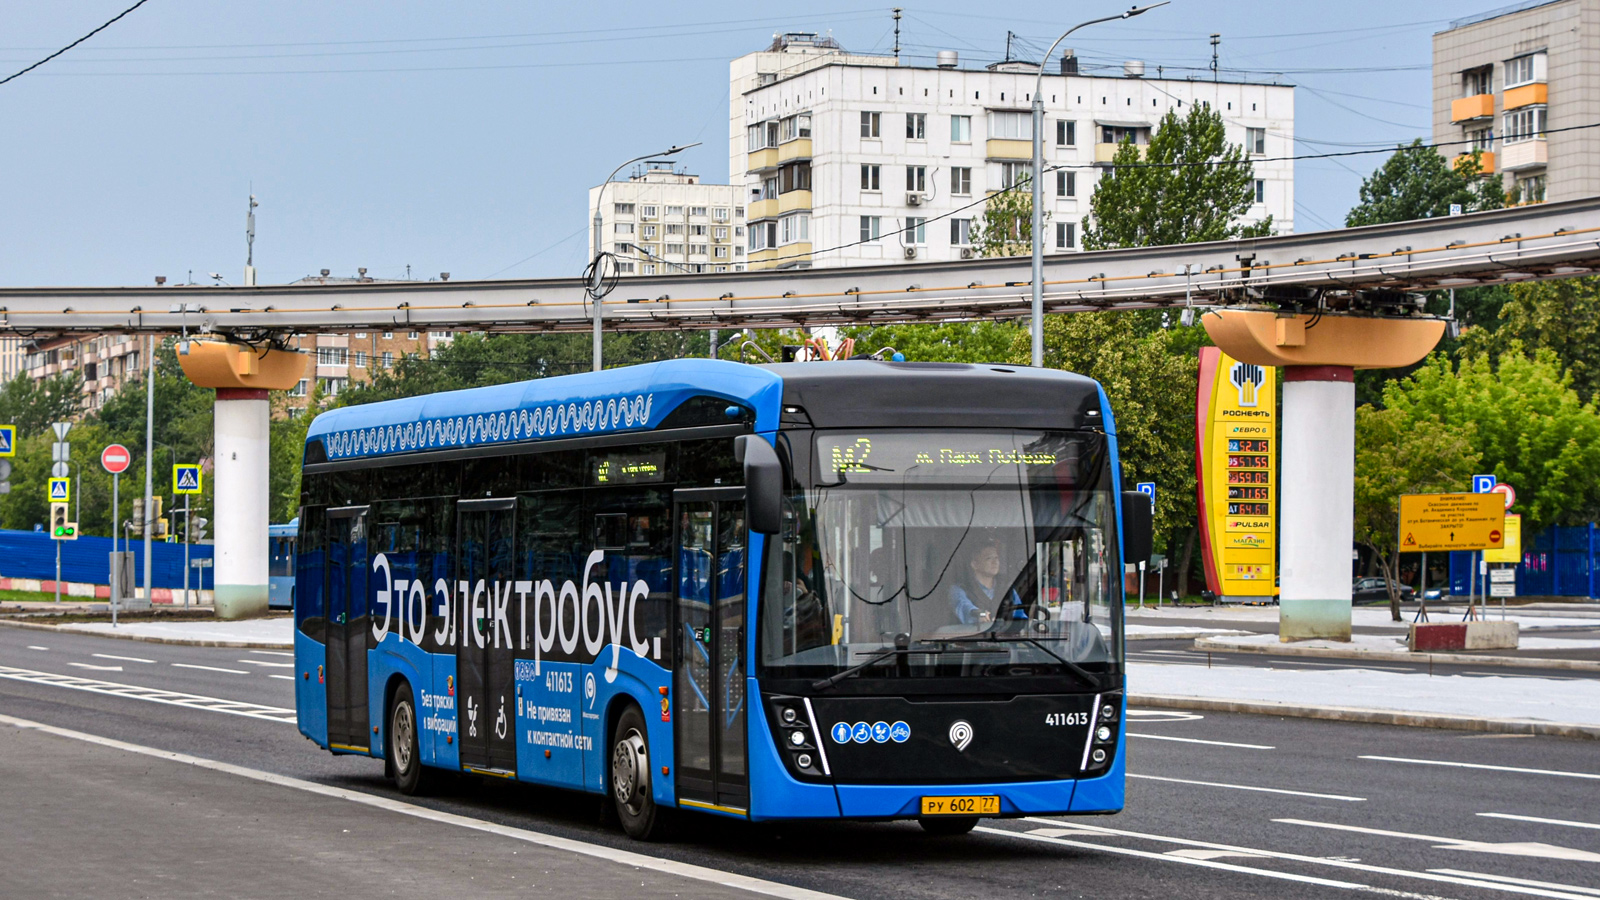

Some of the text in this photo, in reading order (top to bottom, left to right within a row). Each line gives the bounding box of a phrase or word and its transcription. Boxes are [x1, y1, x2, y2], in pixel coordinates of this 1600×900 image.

[1229, 441, 1267, 452] 92 52.15
[1229, 457, 1267, 468] 95 57.55
[1239, 472, 1267, 483] 59.05
[1240, 488, 1267, 499] 71.65
[1239, 504, 1267, 515] 64.60
[372, 553, 426, 646] Это
[546, 671, 573, 693] 411613
[421, 689, 454, 712] Без тряски
[526, 700, 537, 720] Не
[538, 706, 571, 725] привязан
[1045, 712, 1088, 726] 411613
[427, 713, 457, 735] вибраций
[527, 730, 593, 751] к контактной сети
[950, 798, 975, 812] 602
[982, 797, 995, 808] 77
